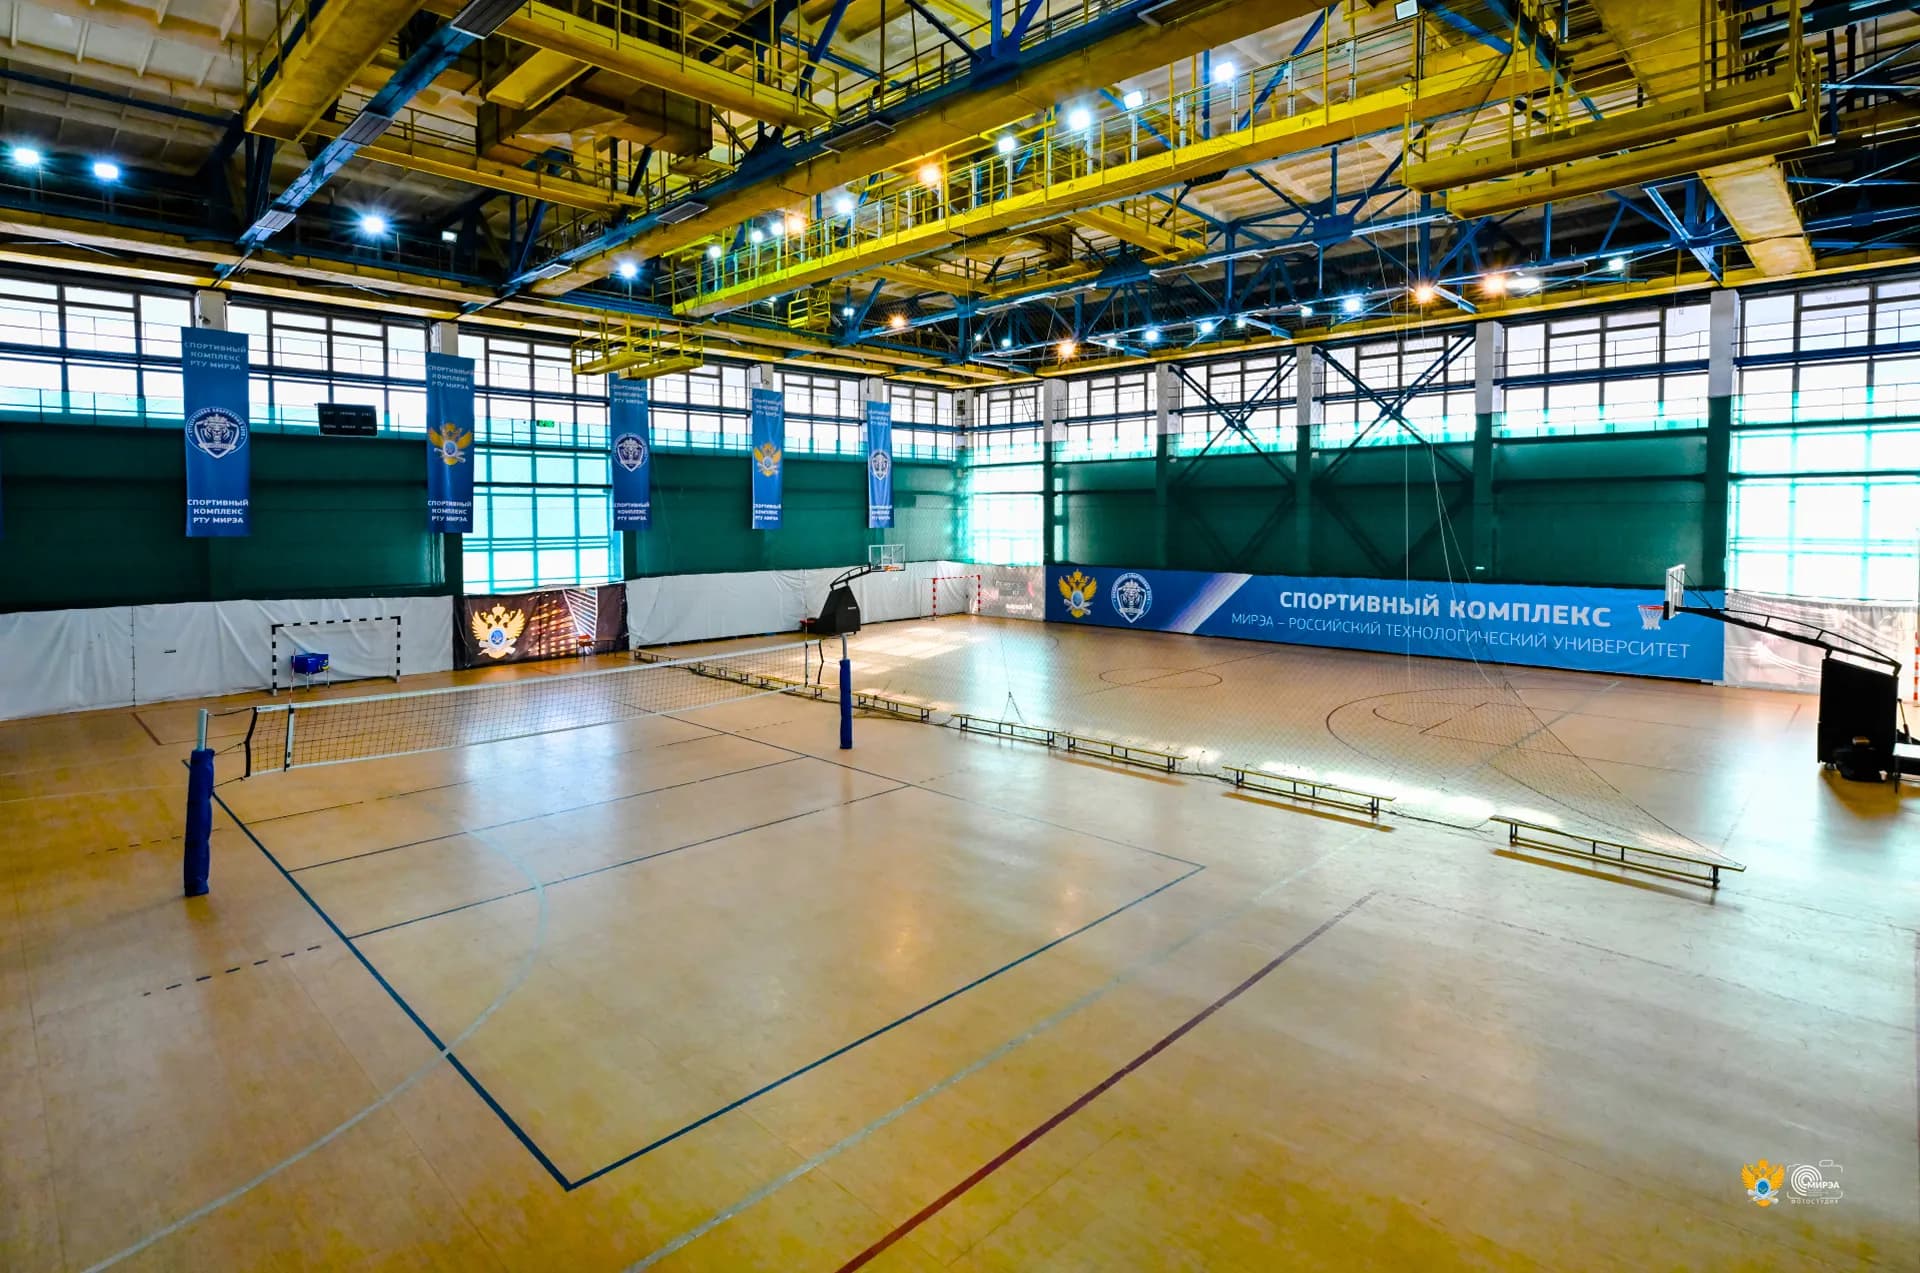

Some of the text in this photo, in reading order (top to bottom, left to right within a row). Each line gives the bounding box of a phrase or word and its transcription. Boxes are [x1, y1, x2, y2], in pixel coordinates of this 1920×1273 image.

[184, 341, 247, 353] СПОРТИВНЫЙ
[190, 351, 241, 361] КОМПЛЕКС
[210, 361, 241, 370] МИРЭА
[1280, 591, 1612, 627] СПОРТИВНЫЙ КОМПЛЕКС
[1231, 613, 1274, 627] МИРЭА
[1289, 616, 1381, 636] РОССИЙСКИЙ
[1385, 623, 1547, 648] ТЕХНОЛОГИЧЕСКИЙ
[1553, 635, 1691, 659] УНИВЕРСИТЕТ
